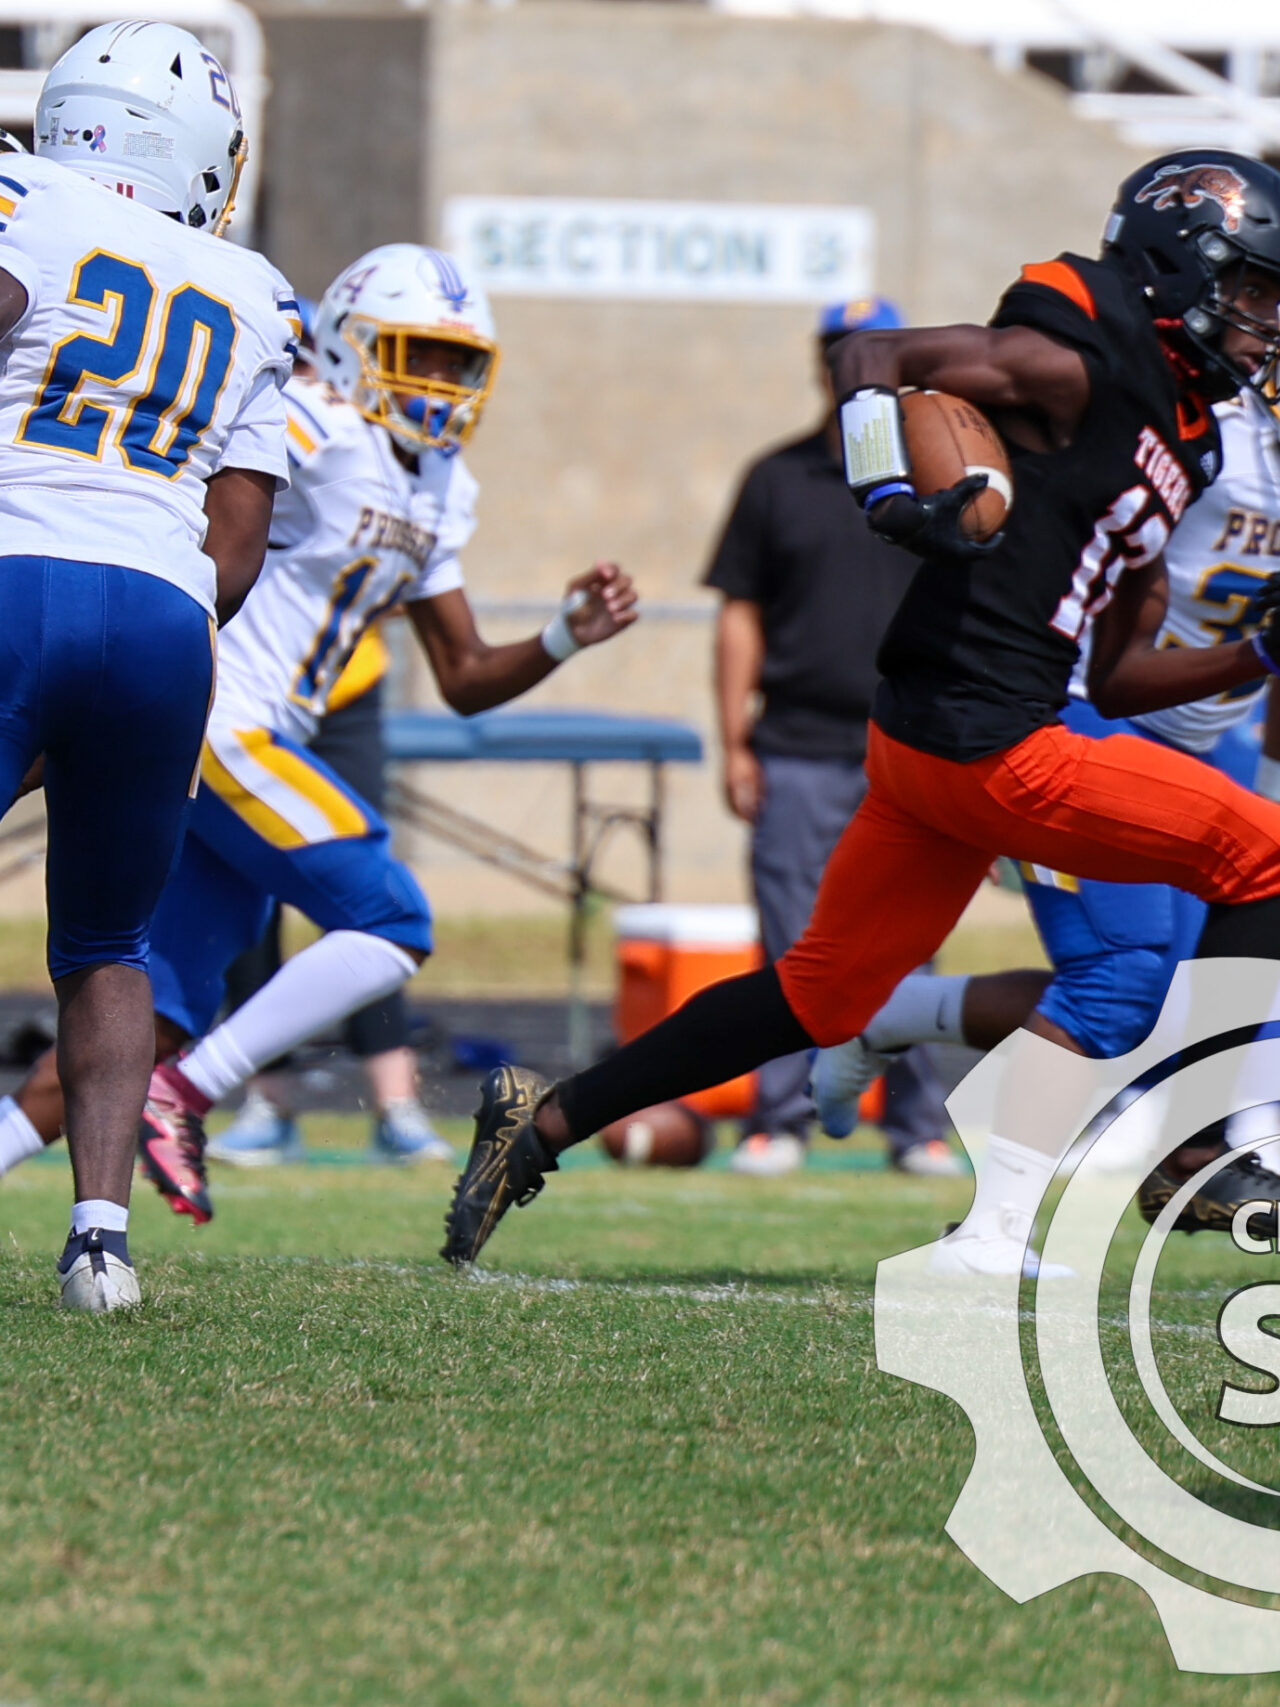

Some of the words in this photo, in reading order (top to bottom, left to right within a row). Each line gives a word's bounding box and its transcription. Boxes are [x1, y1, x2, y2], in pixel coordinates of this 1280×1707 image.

[199, 50, 242, 120] 2
[473, 214, 769, 277] SECTION
[14, 247, 239, 482] 20
